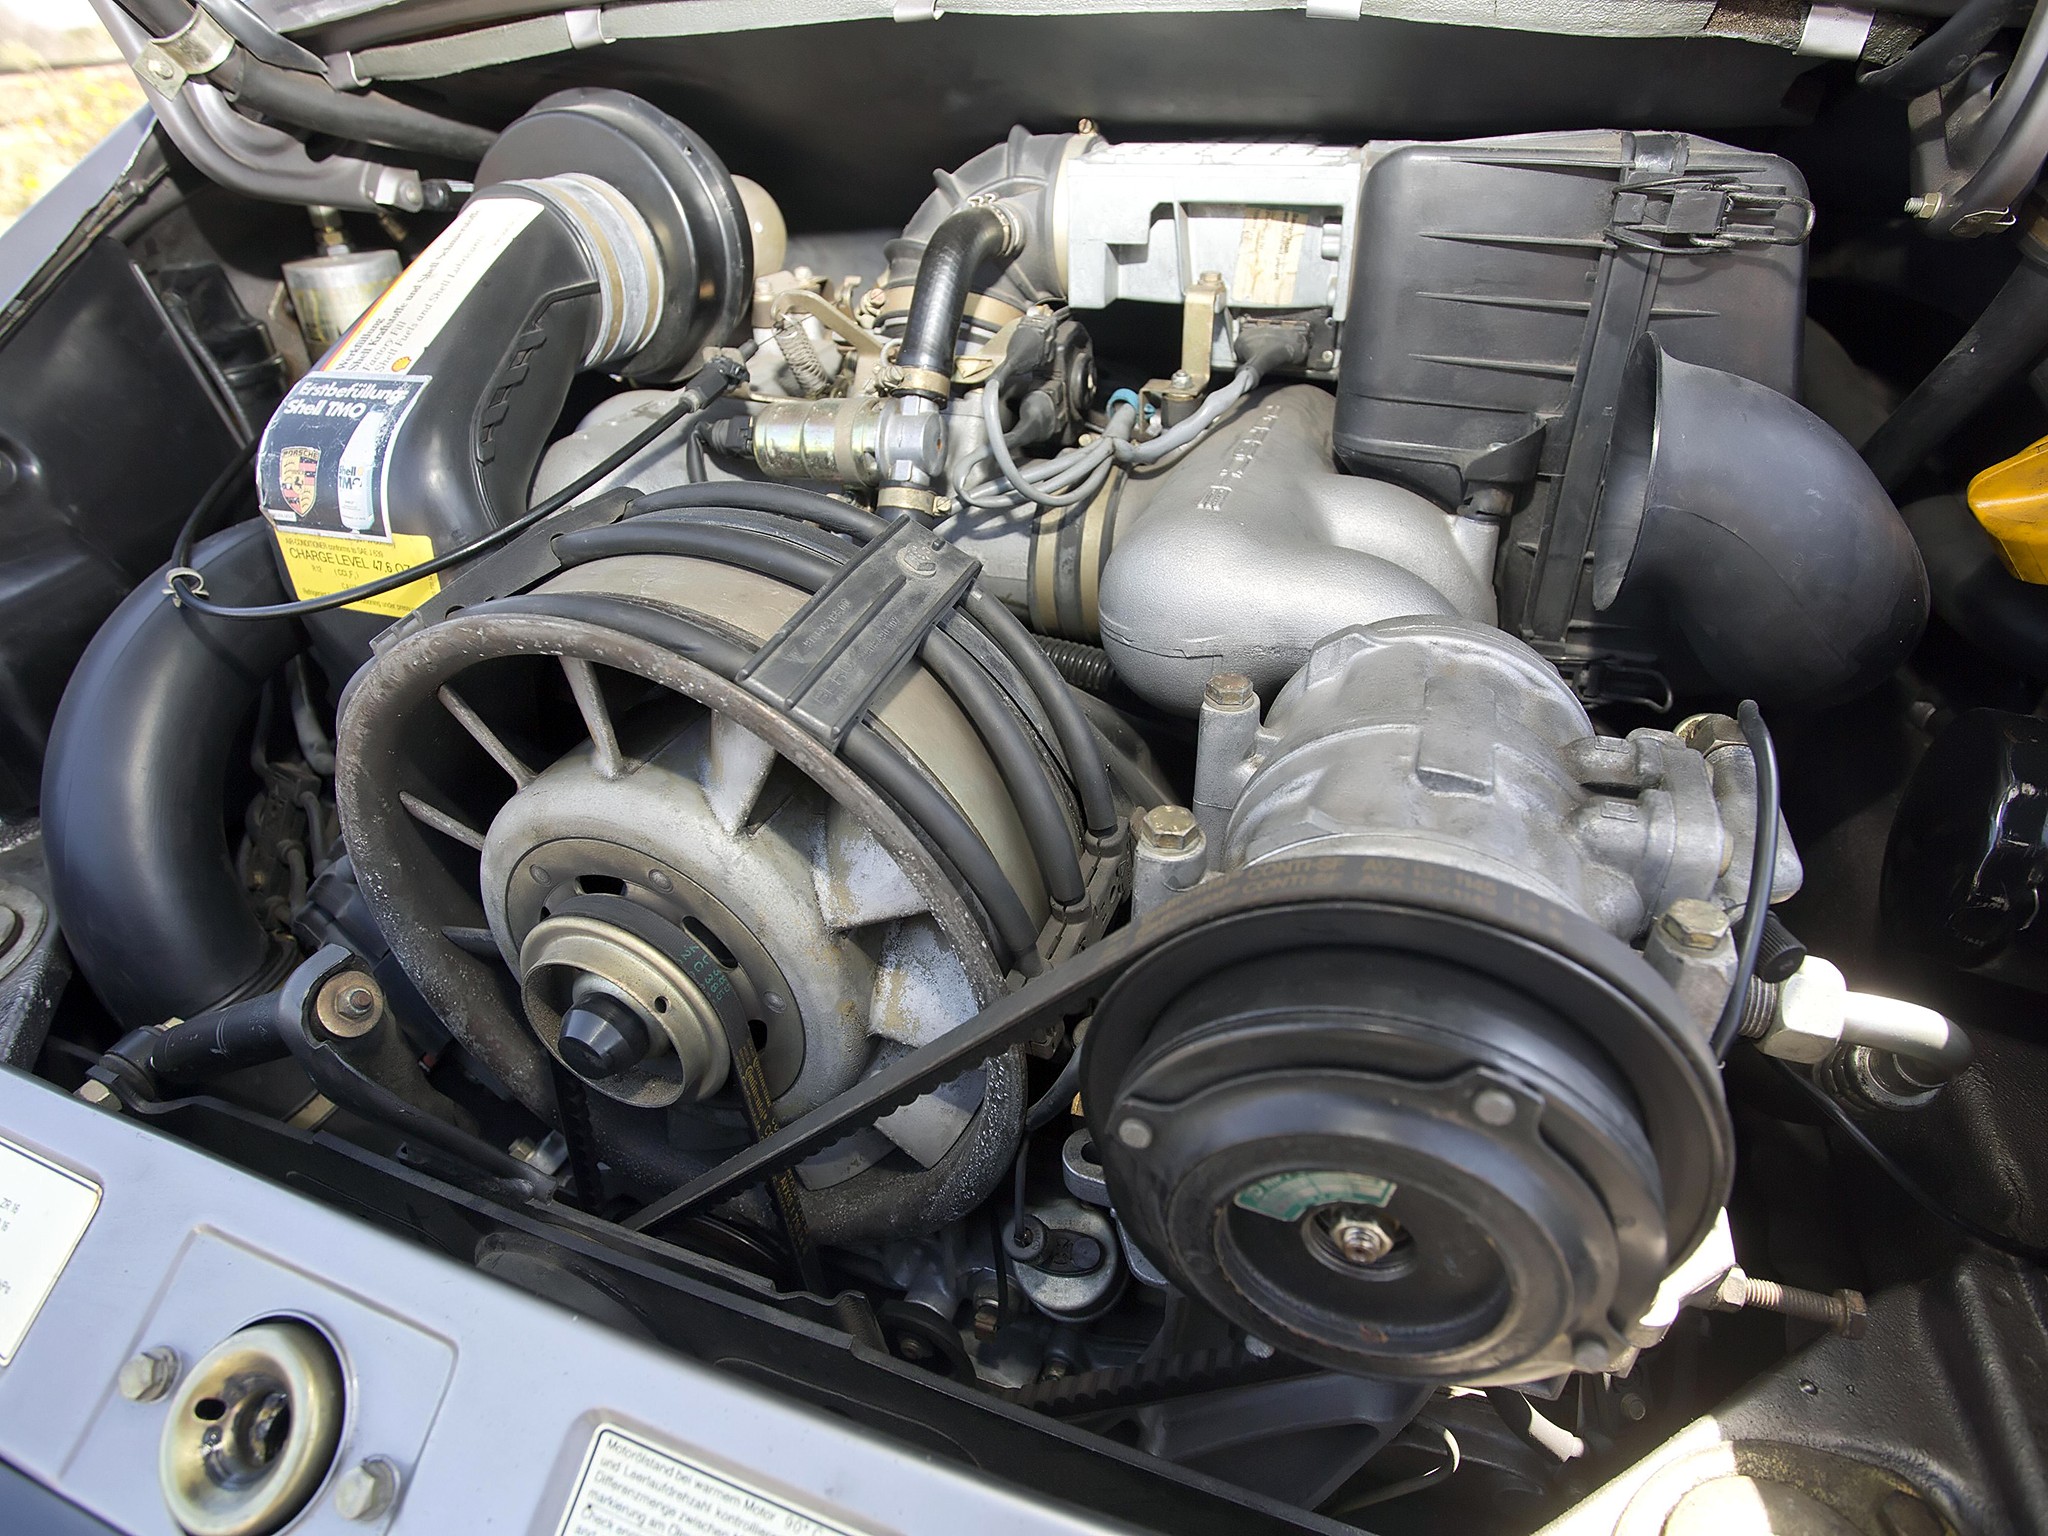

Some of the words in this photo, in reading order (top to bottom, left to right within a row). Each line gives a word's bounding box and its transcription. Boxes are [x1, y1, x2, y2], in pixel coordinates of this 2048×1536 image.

[347, 347, 372, 371] Shell
[368, 302, 407, 346] Kraftstoffe
[418, 261, 439, 282] Shell
[374, 348, 397, 371] Shell
[394, 322, 417, 346] Fuels
[428, 279, 450, 302] Shell
[361, 336, 395, 371] Factory
[283, 399, 324, 416] Shell
[327, 401, 367, 419] TMO
[283, 449, 317, 459] PORSCHE
[289, 547, 334, 564] CHARGE
[335, 554, 370, 570] LEVEL
[593, 1472, 678, 1519] Differenzmenge
[599, 1457, 621, 1472] und
[623, 1466, 713, 1514] Leerlaufdrehzahl
[606, 1439, 675, 1478] Motorölstand
[675, 1471, 693, 1485] bei
[693, 1481, 741, 1507] warmem
[743, 1500, 776, 1522] Motor
[587, 1489, 648, 1525] markierung
[647, 1519, 666, 1532] am
